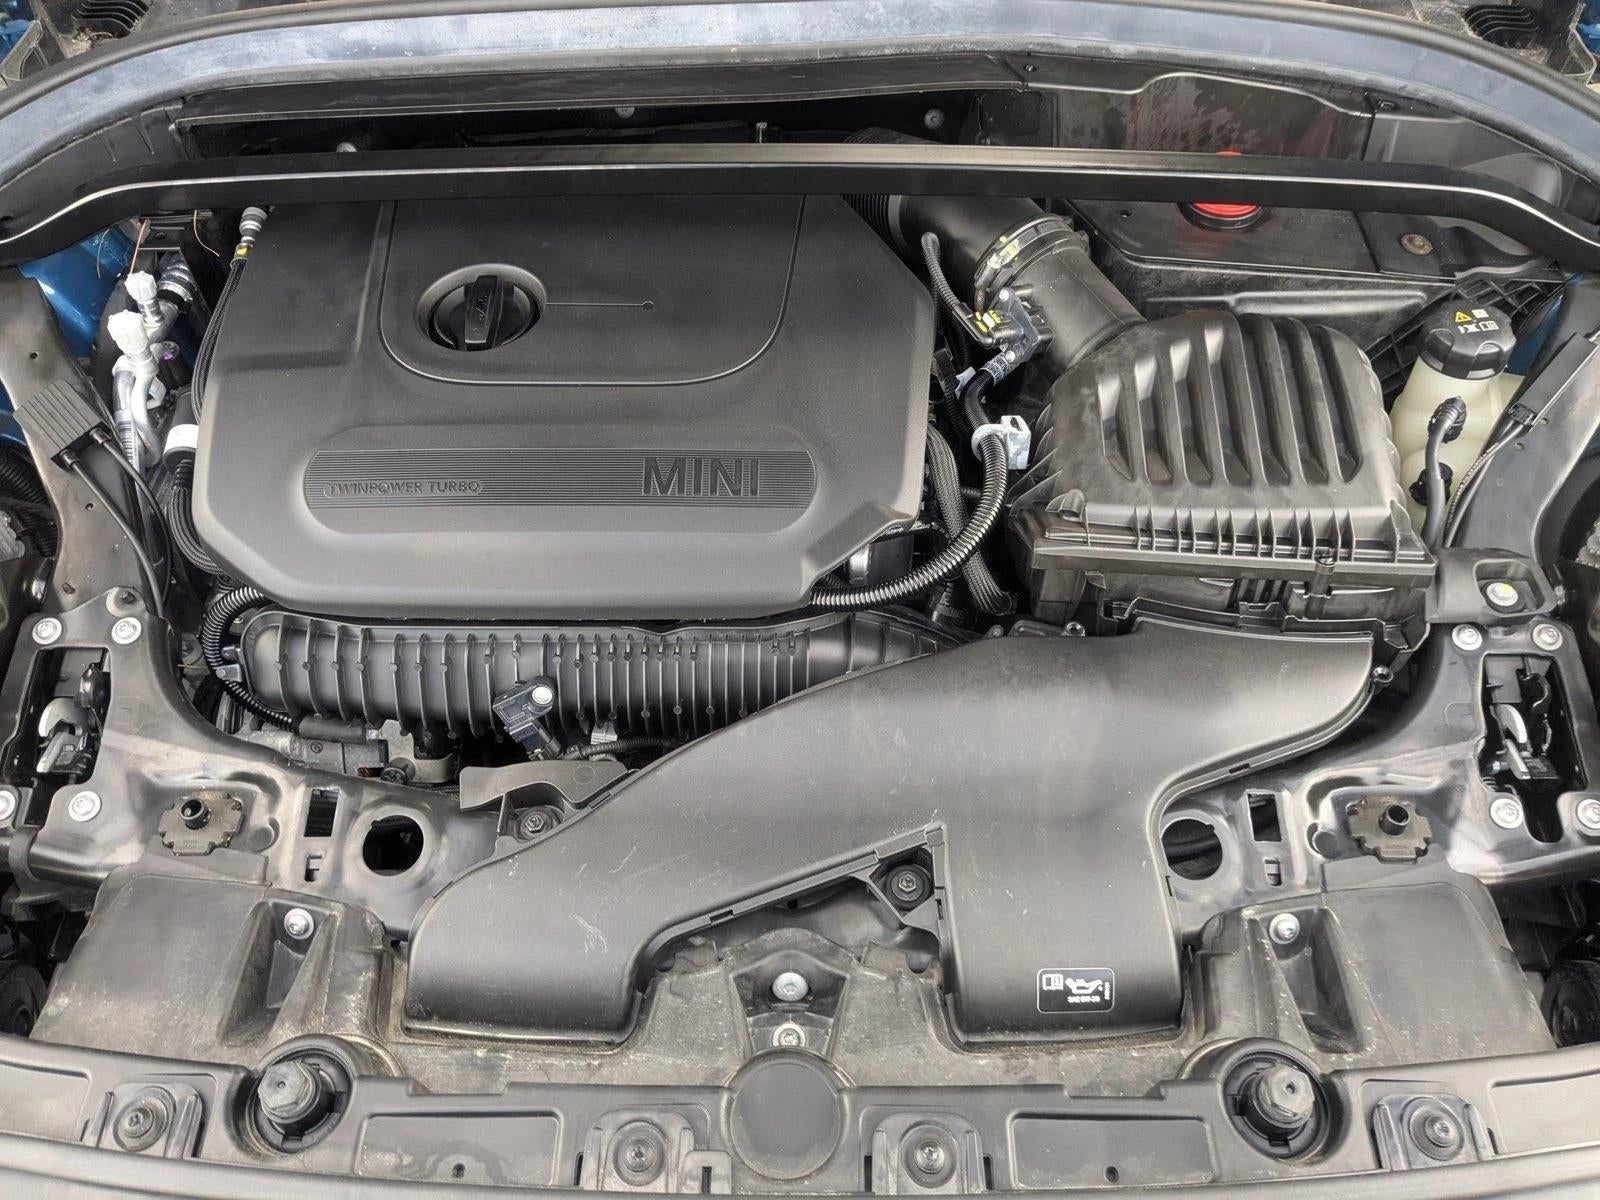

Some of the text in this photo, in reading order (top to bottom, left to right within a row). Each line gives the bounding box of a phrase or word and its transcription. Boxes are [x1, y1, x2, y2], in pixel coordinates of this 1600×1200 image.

[328, 480, 479, 495] TWINPOWER TURBO
[643, 457, 759, 496] MINI
